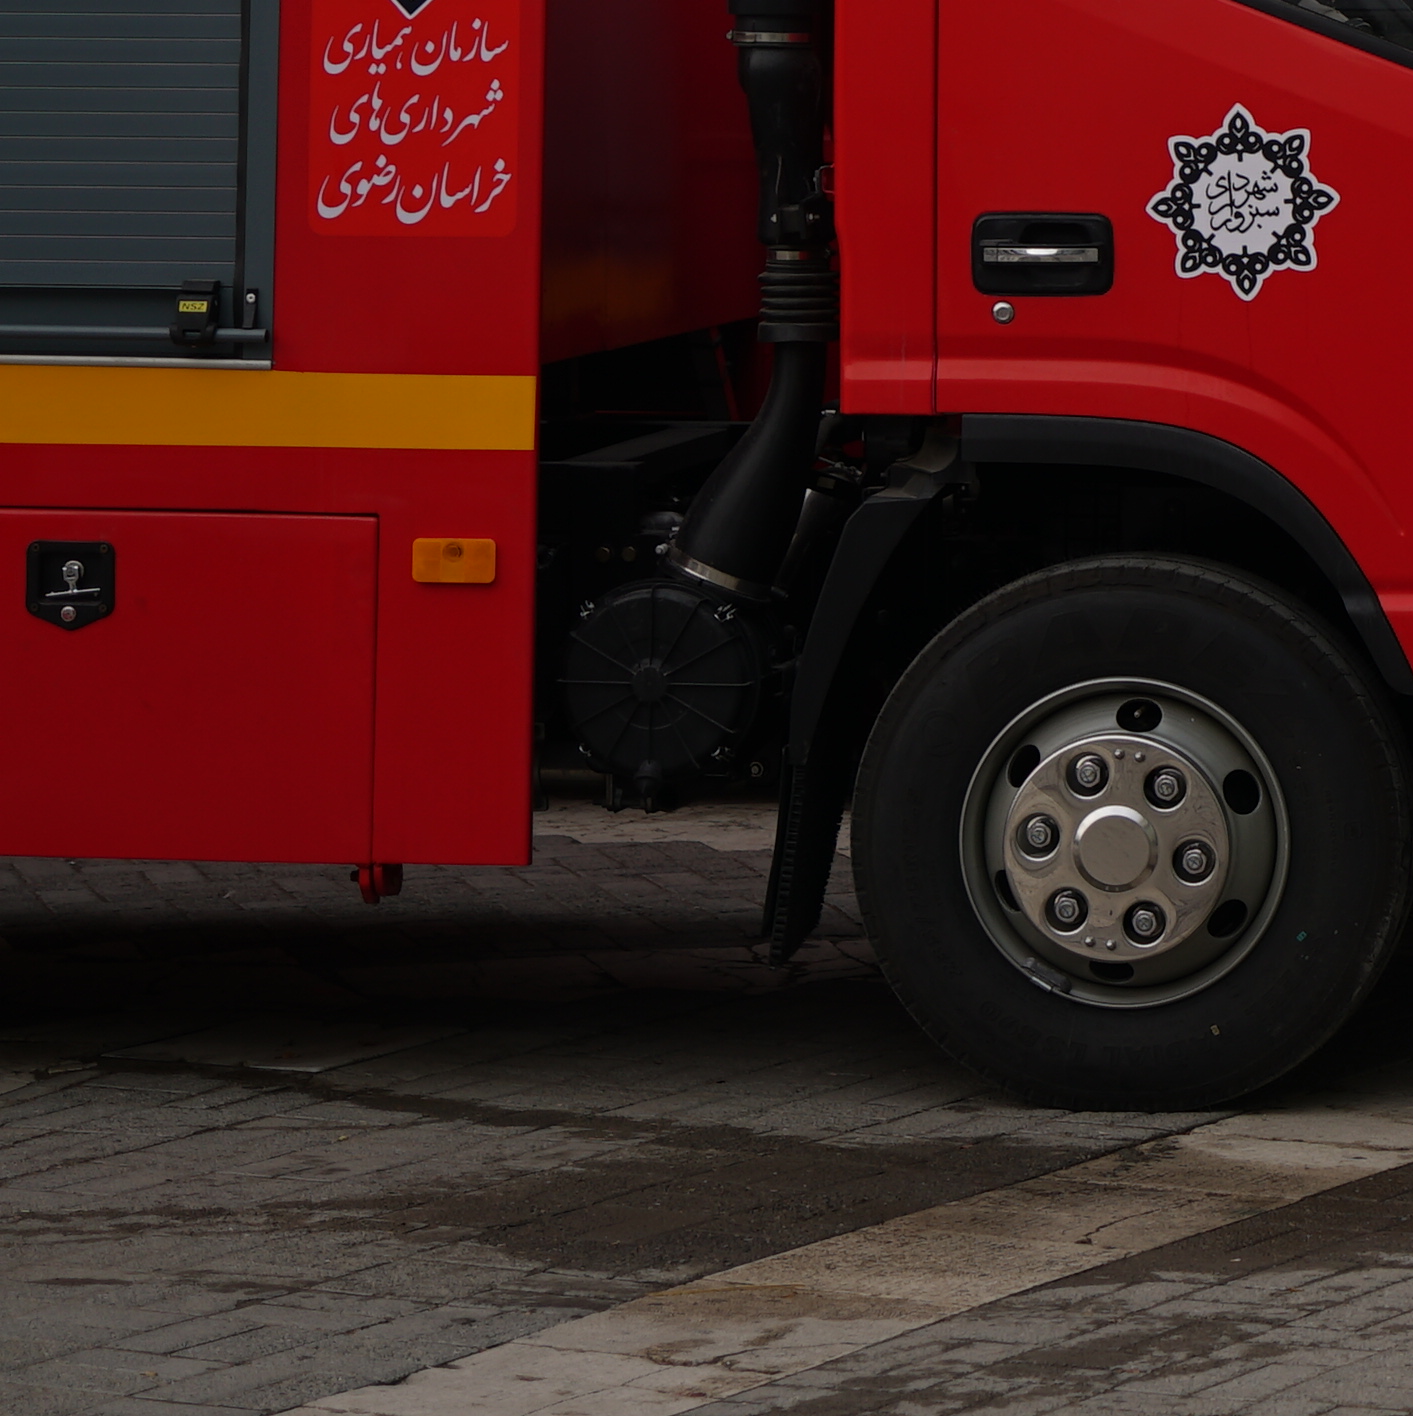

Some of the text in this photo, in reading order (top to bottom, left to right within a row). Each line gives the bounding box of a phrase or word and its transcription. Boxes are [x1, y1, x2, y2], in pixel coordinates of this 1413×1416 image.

[322, 18, 509, 76] سازمان همیاری
[329, 79, 504, 147] شهرداری های
[316, 154, 512, 224] خراسان رضوی
[181, 302, 205, 311] NSZ
